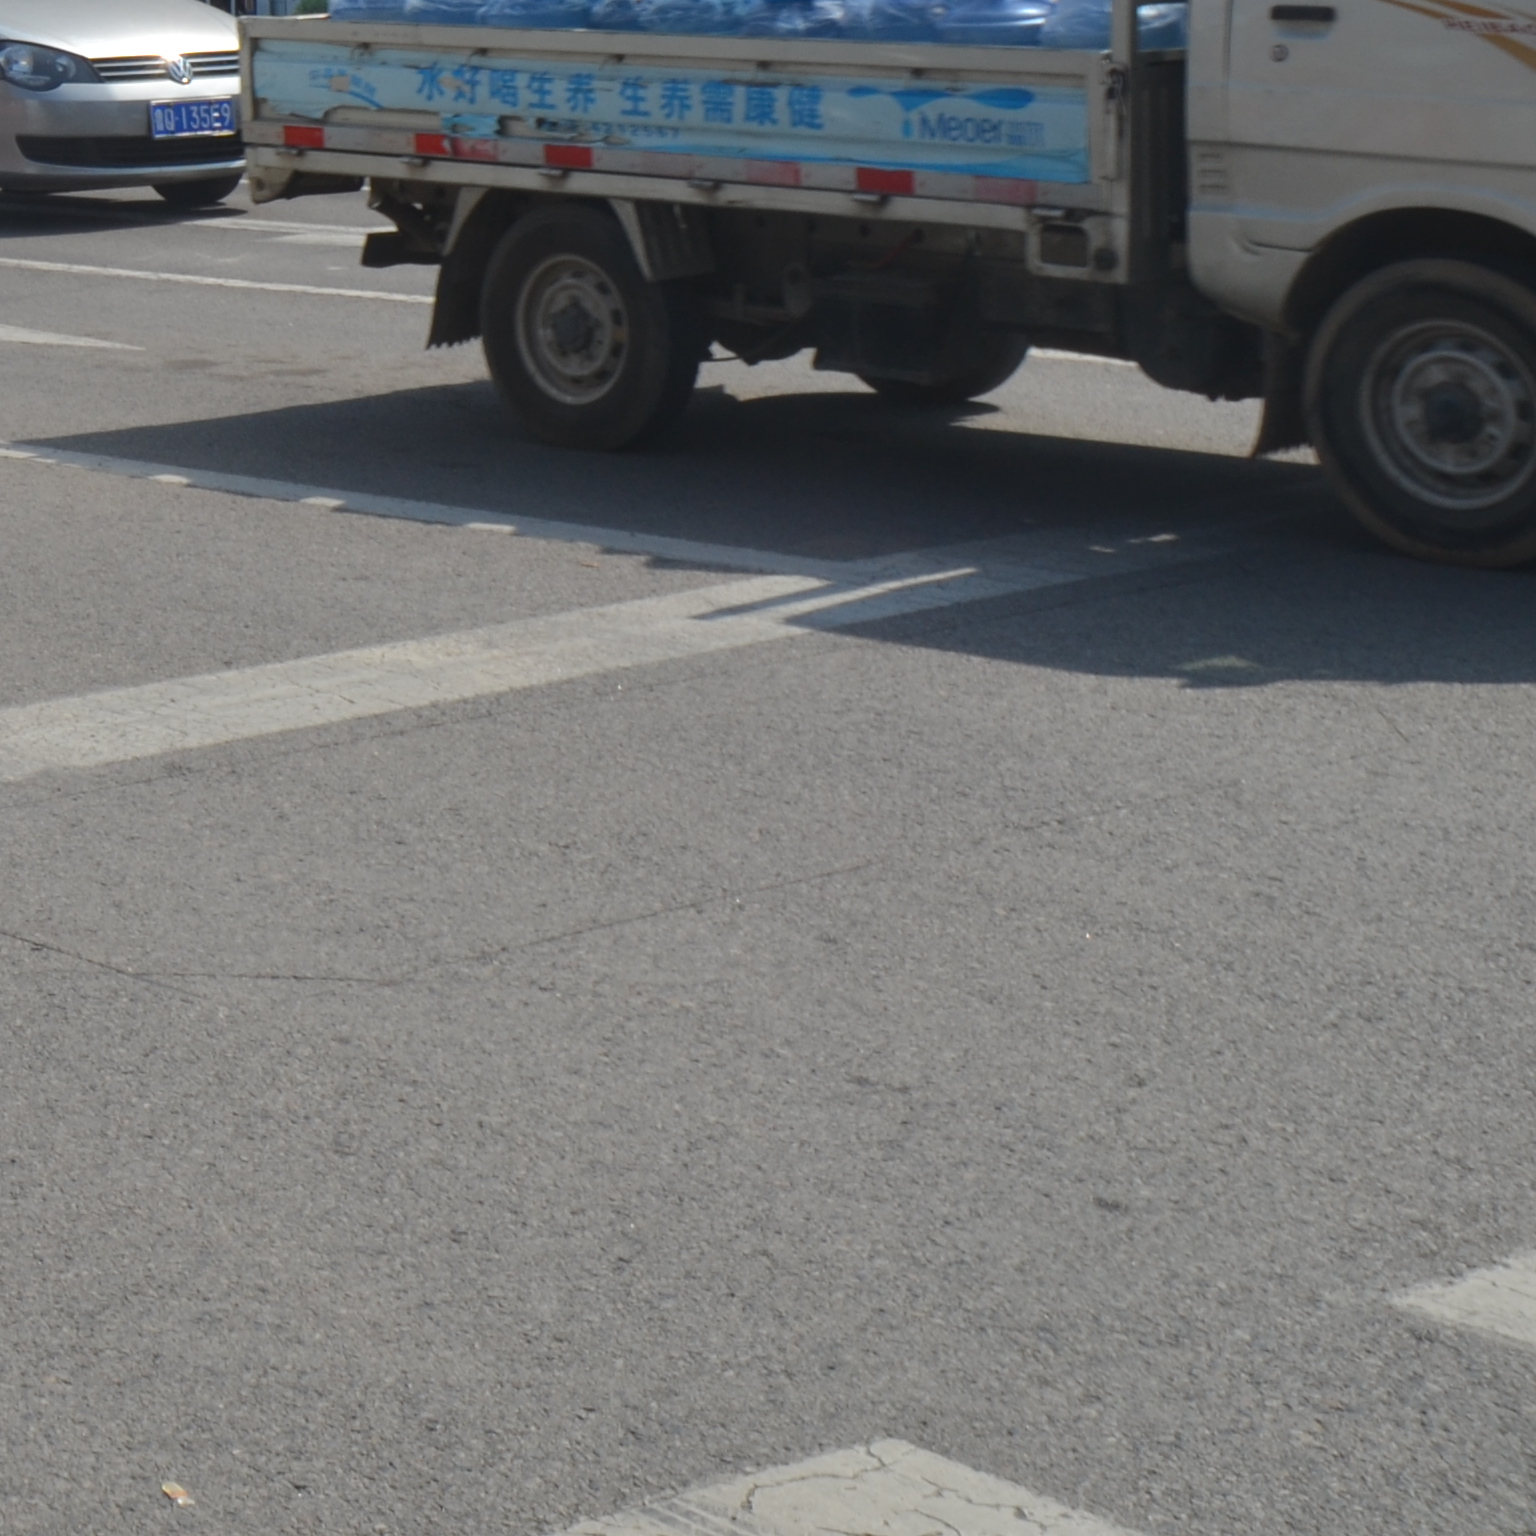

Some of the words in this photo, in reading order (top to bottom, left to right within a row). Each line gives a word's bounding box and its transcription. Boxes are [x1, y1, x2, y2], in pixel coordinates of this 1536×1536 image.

[621, 75, 824, 131] 生养需康健
